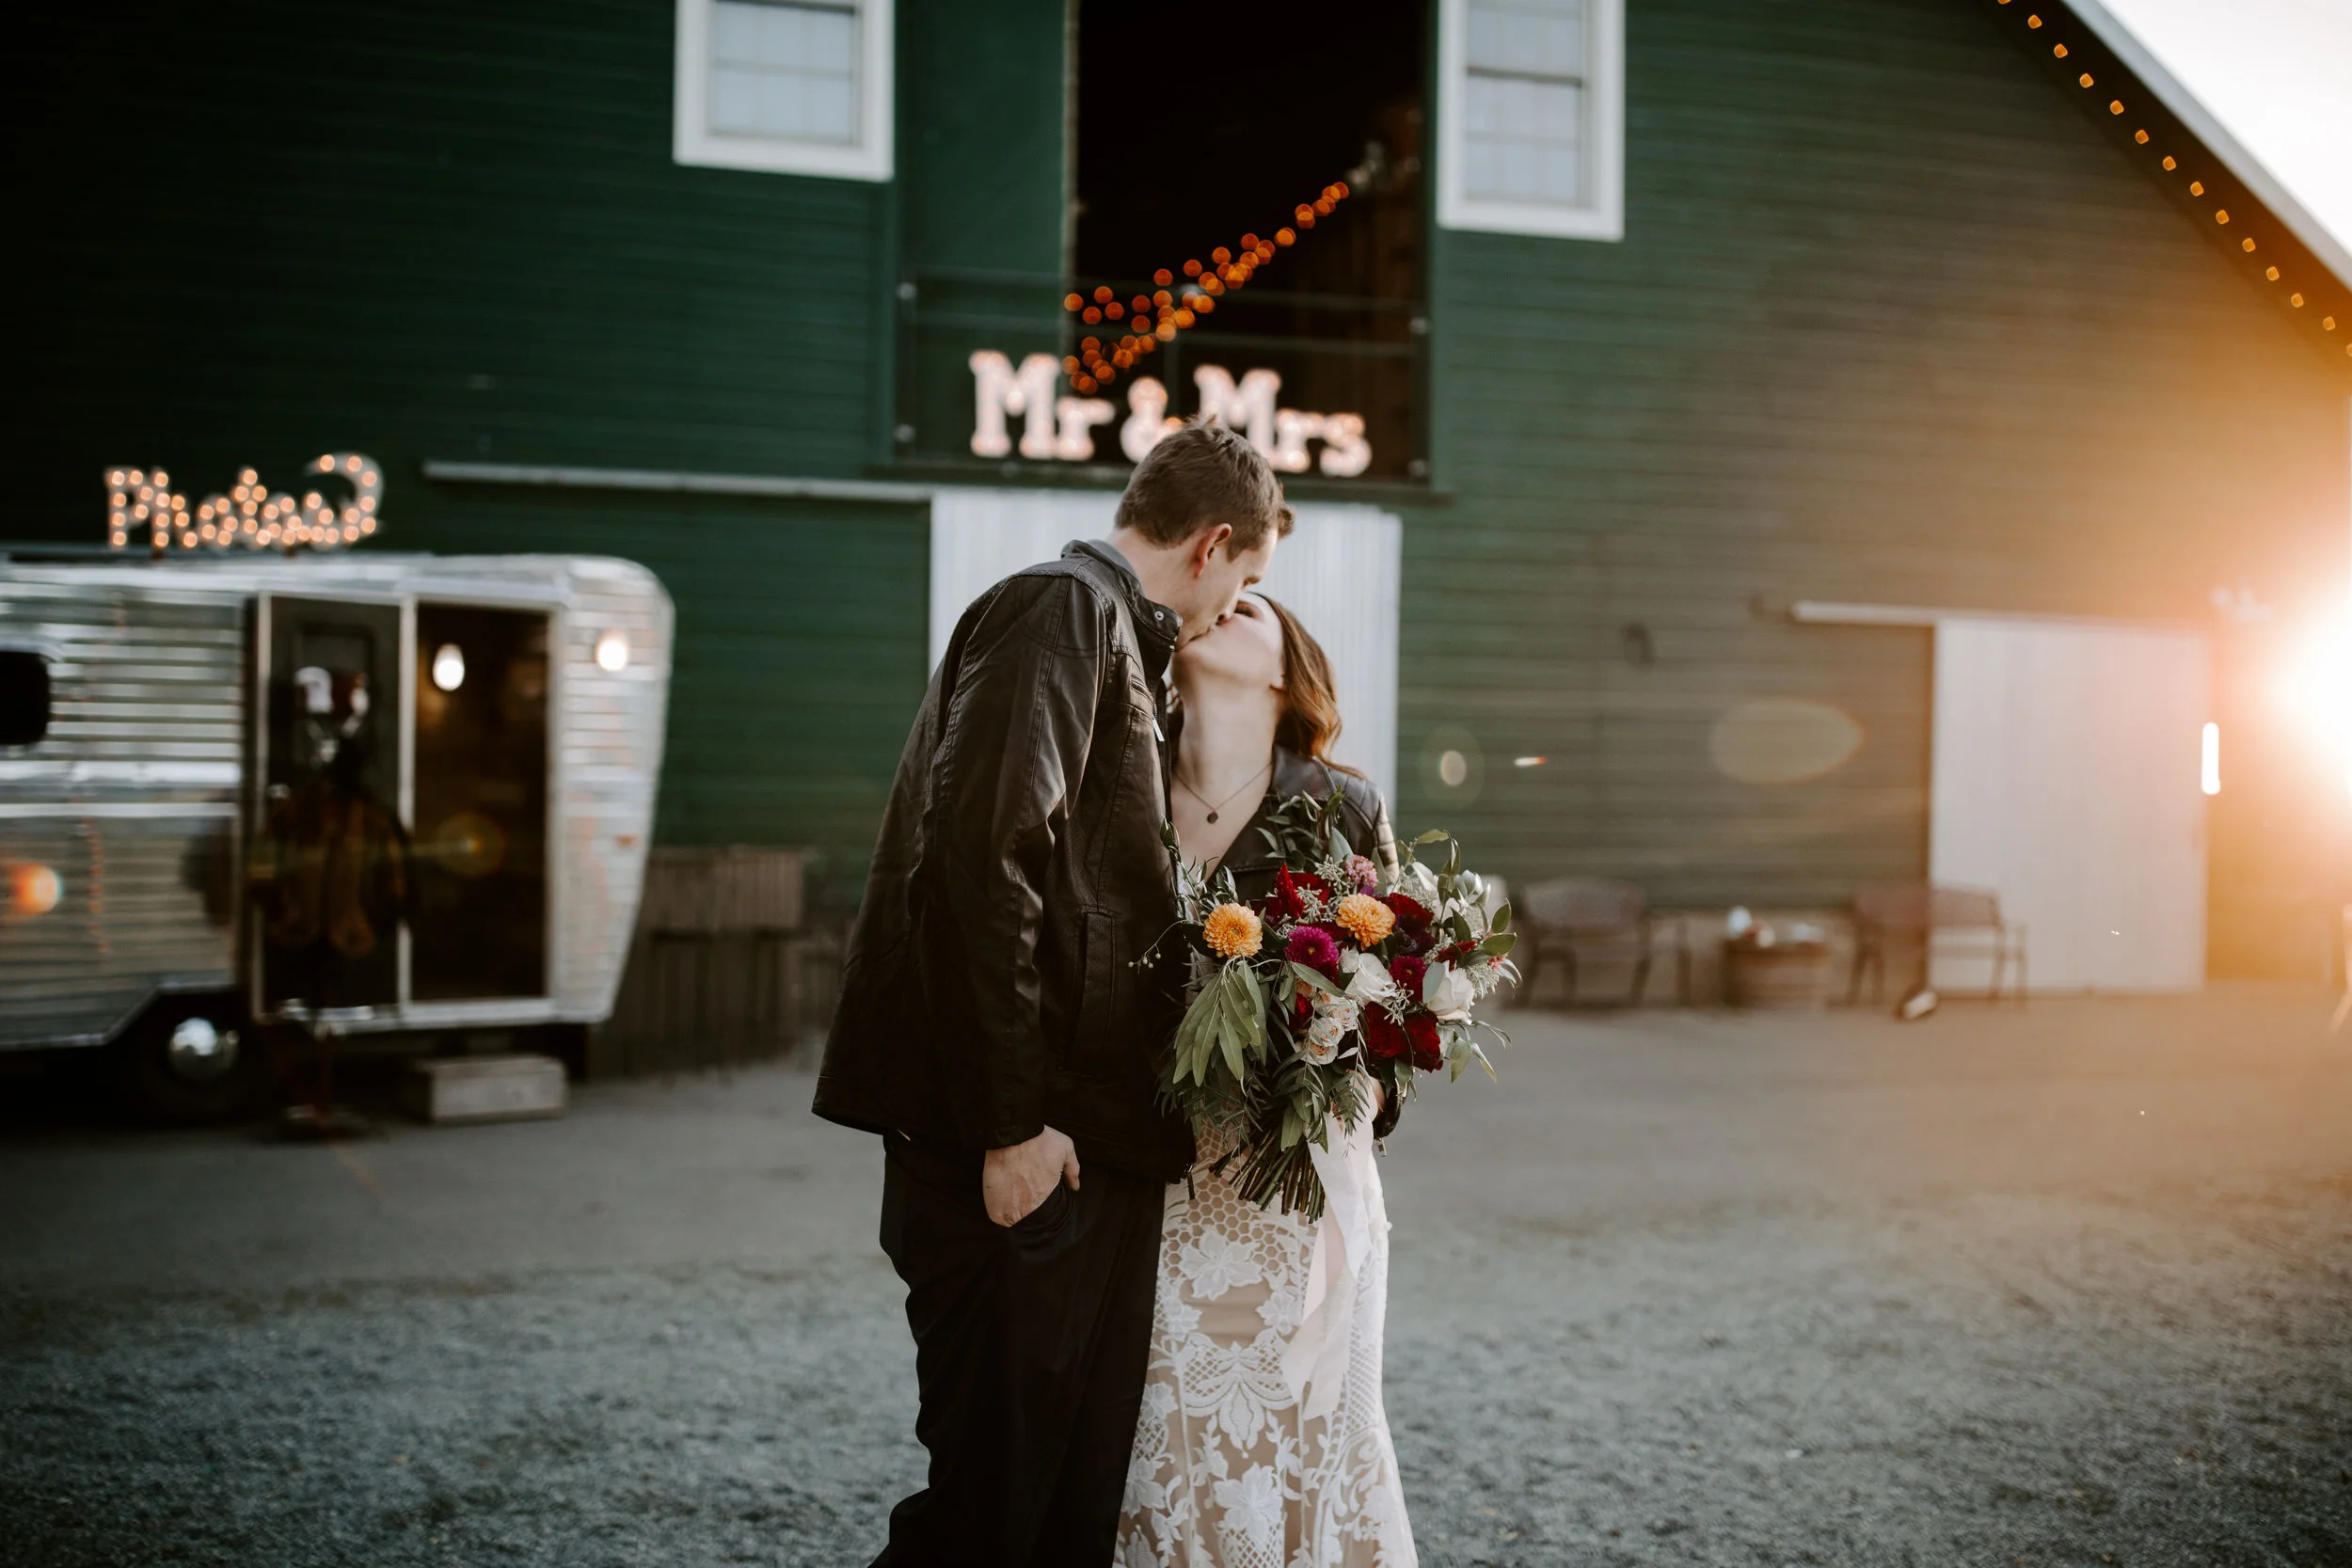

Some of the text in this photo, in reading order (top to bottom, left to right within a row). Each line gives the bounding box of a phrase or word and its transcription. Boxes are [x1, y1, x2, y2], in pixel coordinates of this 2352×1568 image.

[969, 350, 1372, 477] Mr & Mrs
